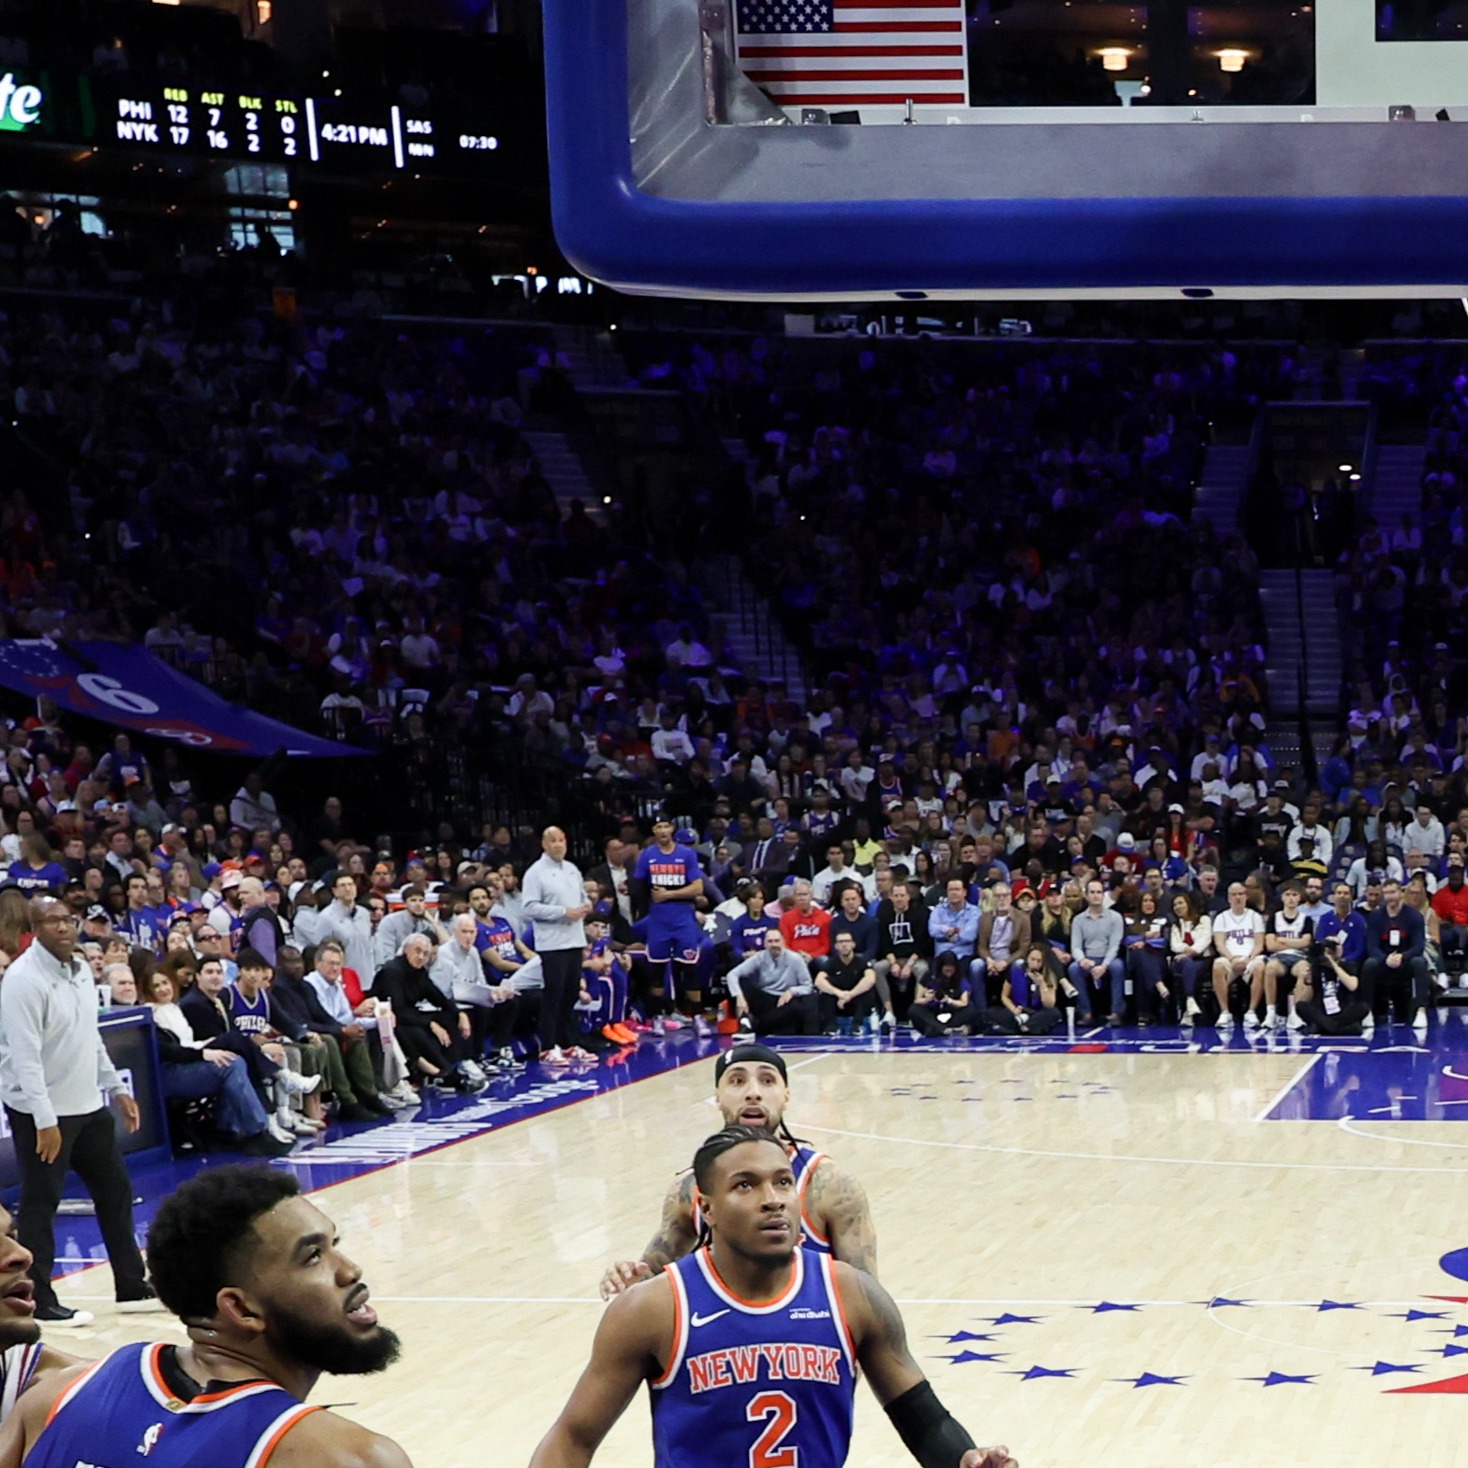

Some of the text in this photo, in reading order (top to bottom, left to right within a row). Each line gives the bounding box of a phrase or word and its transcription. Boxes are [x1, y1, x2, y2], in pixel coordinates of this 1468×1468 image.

[201, 92, 225, 106] AST
[239, 96, 262, 110] BLK
[275, 100, 298, 113] STL
[118, 99, 295, 135] PHI 12 7 2 0
[406, 120, 432, 134] SAS
[117, 121, 297, 155] NYK 17 16 2 2
[321, 123, 388, 146] 4:21 PM
[651, 874, 686, 885] KNICKS
[686, 1342, 841, 1394] NEW YORK
